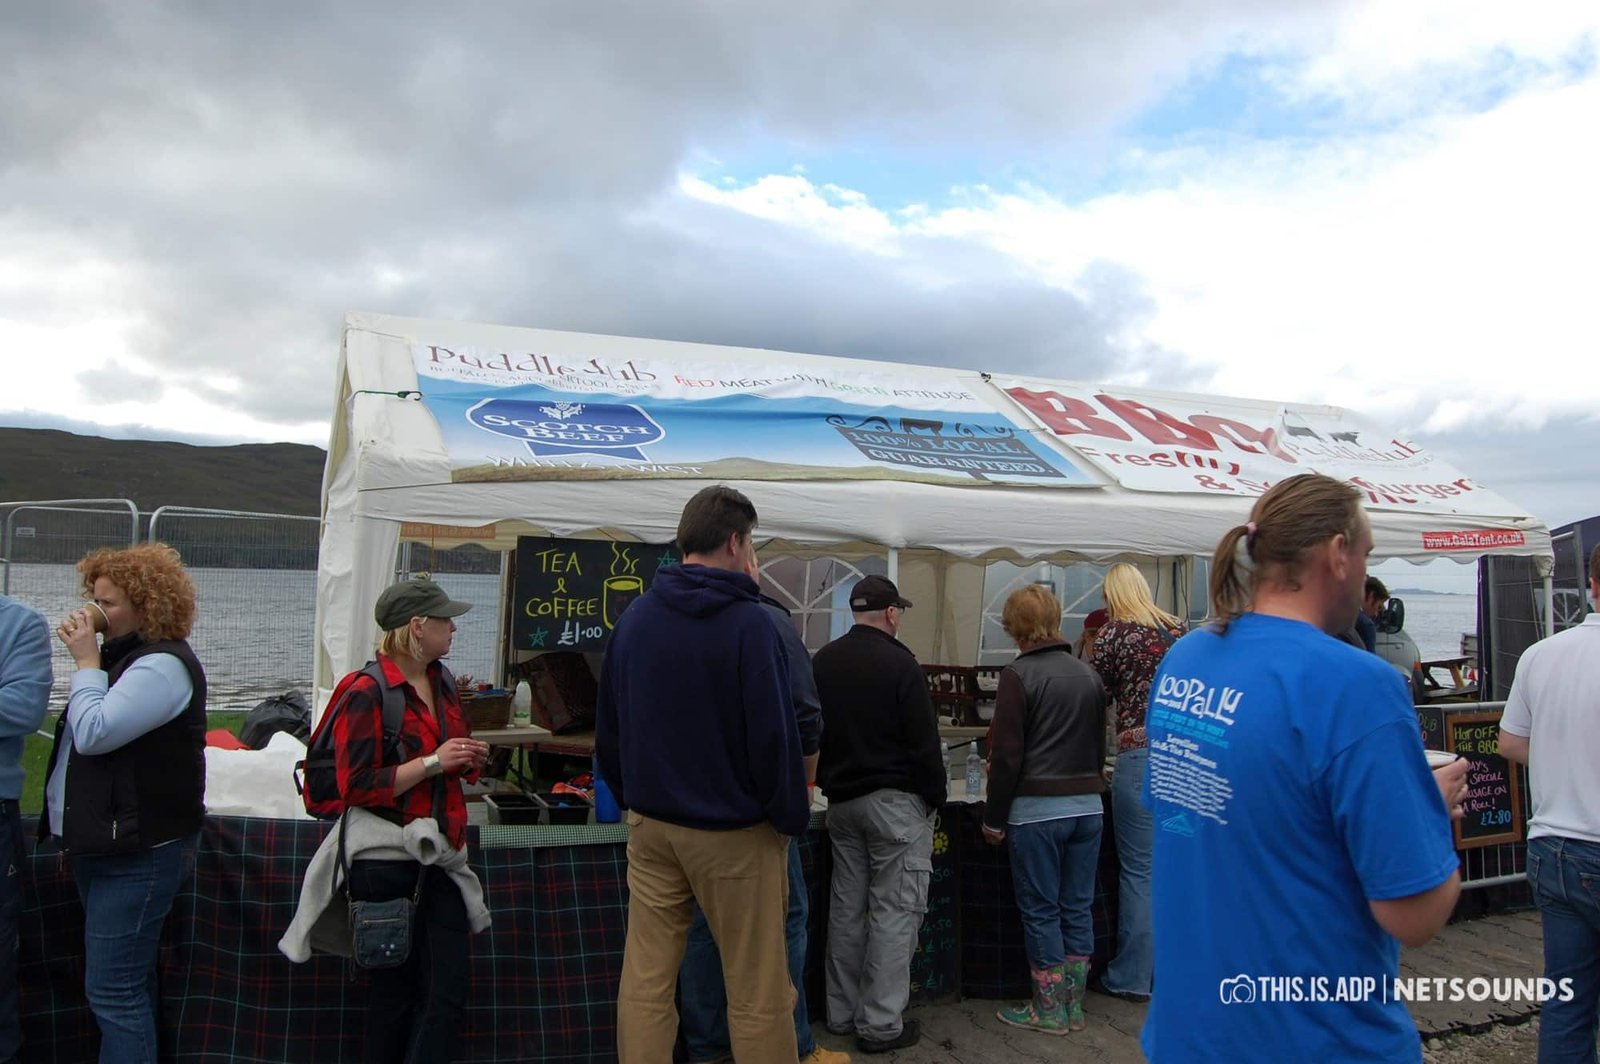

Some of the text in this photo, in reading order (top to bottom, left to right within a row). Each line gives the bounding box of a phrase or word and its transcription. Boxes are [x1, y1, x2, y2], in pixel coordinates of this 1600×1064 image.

[674, 375, 715, 388] RED
[719, 378, 772, 388] MEAT
[892, 389, 976, 400] ATTITUDE
[482, 414, 652, 436] SCOTCH
[523, 426, 625, 442] BEEF
[849, 431, 923, 449] 100%
[1194, 474, 1235, 491] &
[1425, 531, 1523, 548] www.GalaTent.co.uk
[535, 551, 582, 577] TEA
[552, 577, 568, 594] &
[525, 597, 600, 619] COFFEE
[1454, 726, 1472, 741] HOT
[1456, 741, 1474, 752] THE
[1469, 771, 1504, 785] SPECIAL
[1493, 785, 1507, 795] ON
